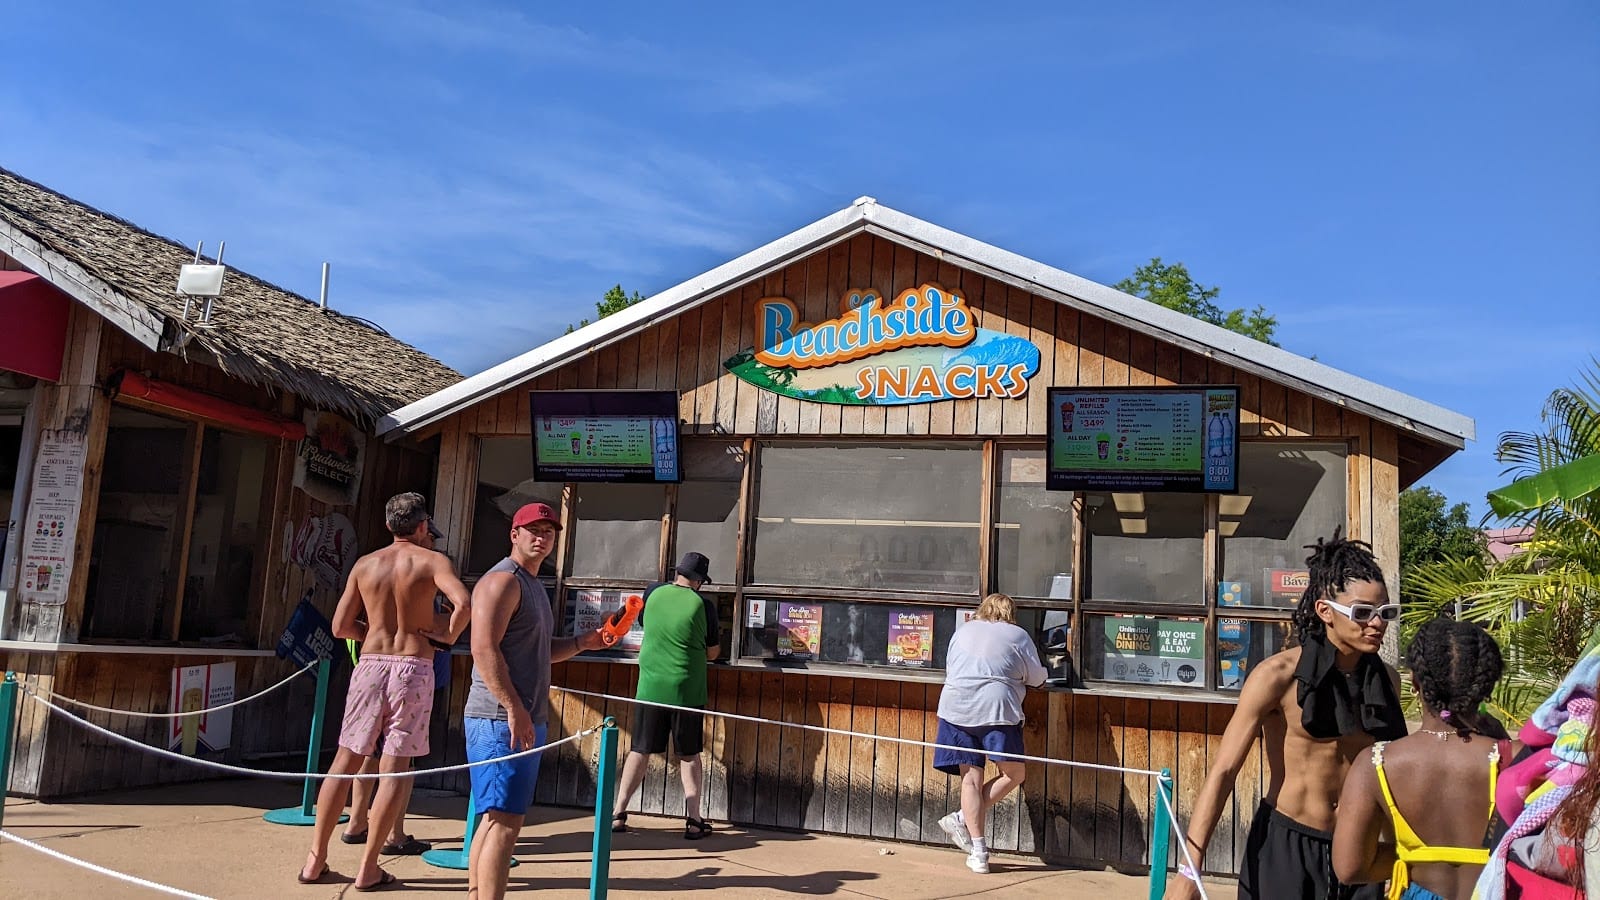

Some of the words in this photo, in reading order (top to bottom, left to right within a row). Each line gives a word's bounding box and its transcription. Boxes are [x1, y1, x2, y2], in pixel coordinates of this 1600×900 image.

[762, 286, 971, 359] Beachside
[856, 363, 1030, 399] SNACKS
[310, 463, 352, 484] SELECT
[1119, 625, 1150, 634] Unlimited
[313, 626, 335, 652] BUD
[1116, 632, 1133, 641] ALL
[1133, 633, 1152, 643] DAY
[1172, 631, 1197, 640] ONCE
[1115, 640, 1151, 651] DINING
[1172, 638, 1188, 646] EAT
[1176, 645, 1192, 654] DAY
